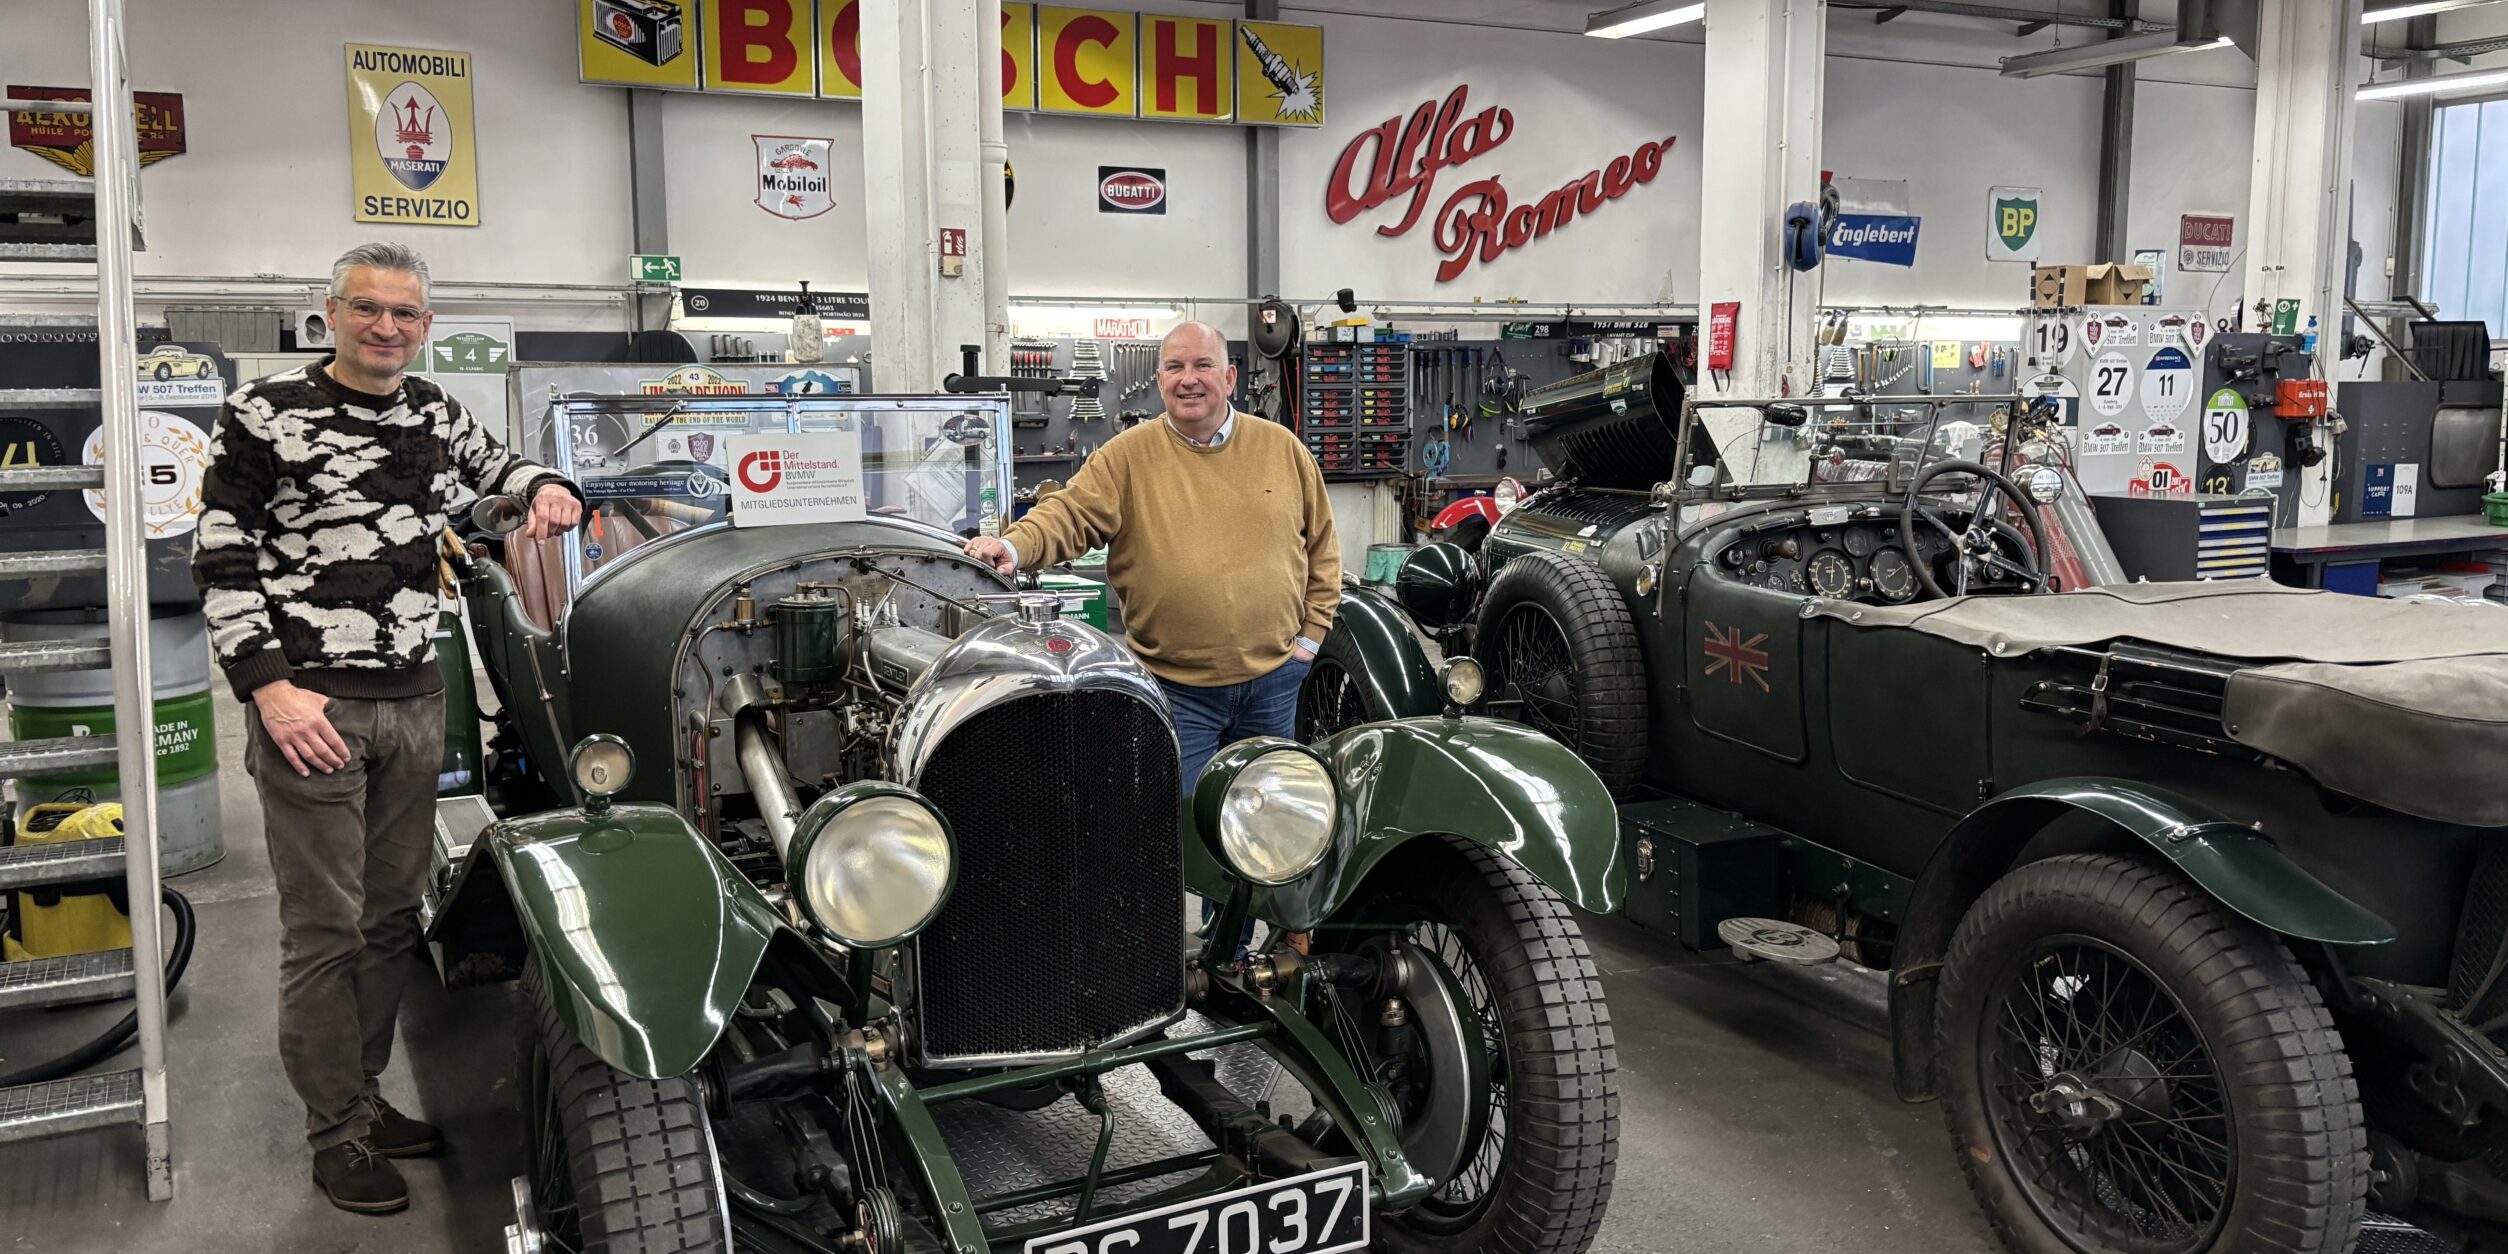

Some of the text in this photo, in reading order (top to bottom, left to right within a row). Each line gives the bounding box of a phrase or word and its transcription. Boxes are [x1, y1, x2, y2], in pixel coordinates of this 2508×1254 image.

[353, 50, 465, 78] AUTOMOBILI
[718, 0, 1221, 115] BCH
[16, 97, 178, 132] AEROELL
[31, 126, 64, 136] HUILE
[775, 144, 812, 157] GARGOYLE
[390, 160, 440, 173] MASERATI
[1326, 84, 1514, 237] Alfa
[762, 174, 827, 193] Mobiloil
[1107, 184, 1156, 199] BUGATTI
[364, 196, 470, 219] SERVIZIO
[1434, 135, 1677, 282] Romeo
[2001, 207, 2035, 238] BP
[1832, 221, 1915, 247] Englebert
[2184, 221, 2231, 242] DUCATI
[2196, 250, 2230, 266] SERVIZIO
[694, 299, 706, 308] 20
[755, 294, 776, 303] 1924
[824, 296, 848, 304] LITRE
[1534, 325, 1550, 334] 298
[2036, 323, 2069, 353] 19
[465, 347, 477, 362] 4
[667, 375, 682, 384] 2022
[708, 374, 722, 384] 2022
[2096, 367, 2128, 396] 27
[2159, 374, 2174, 397] 11
[153, 385, 173, 394] 507
[176, 384, 216, 394] Treffen
[2209, 411, 2239, 444] 50
[571, 424, 599, 446] 36
[161, 435, 195, 464] QUER
[2084, 440, 2129, 453] BMW 507 Treffen
[2138, 440, 2183, 453] BMW 507 Treffen
[783, 450, 800, 460] Der
[784, 460, 840, 471] Mittelstand.
[785, 470, 816, 480] BVMW
[585, 480, 615, 489] Enjoying
[629, 480, 658, 488] motoring
[659, 479, 685, 487] heritage
[2368, 485, 2390, 493] SUPPORT
[2396, 484, 2413, 496] 109A
[740, 496, 858, 510] MITGLIEDSUNTERNEHMEN
[177, 720, 188, 731] IN
[169, 742, 190, 755] 1892
